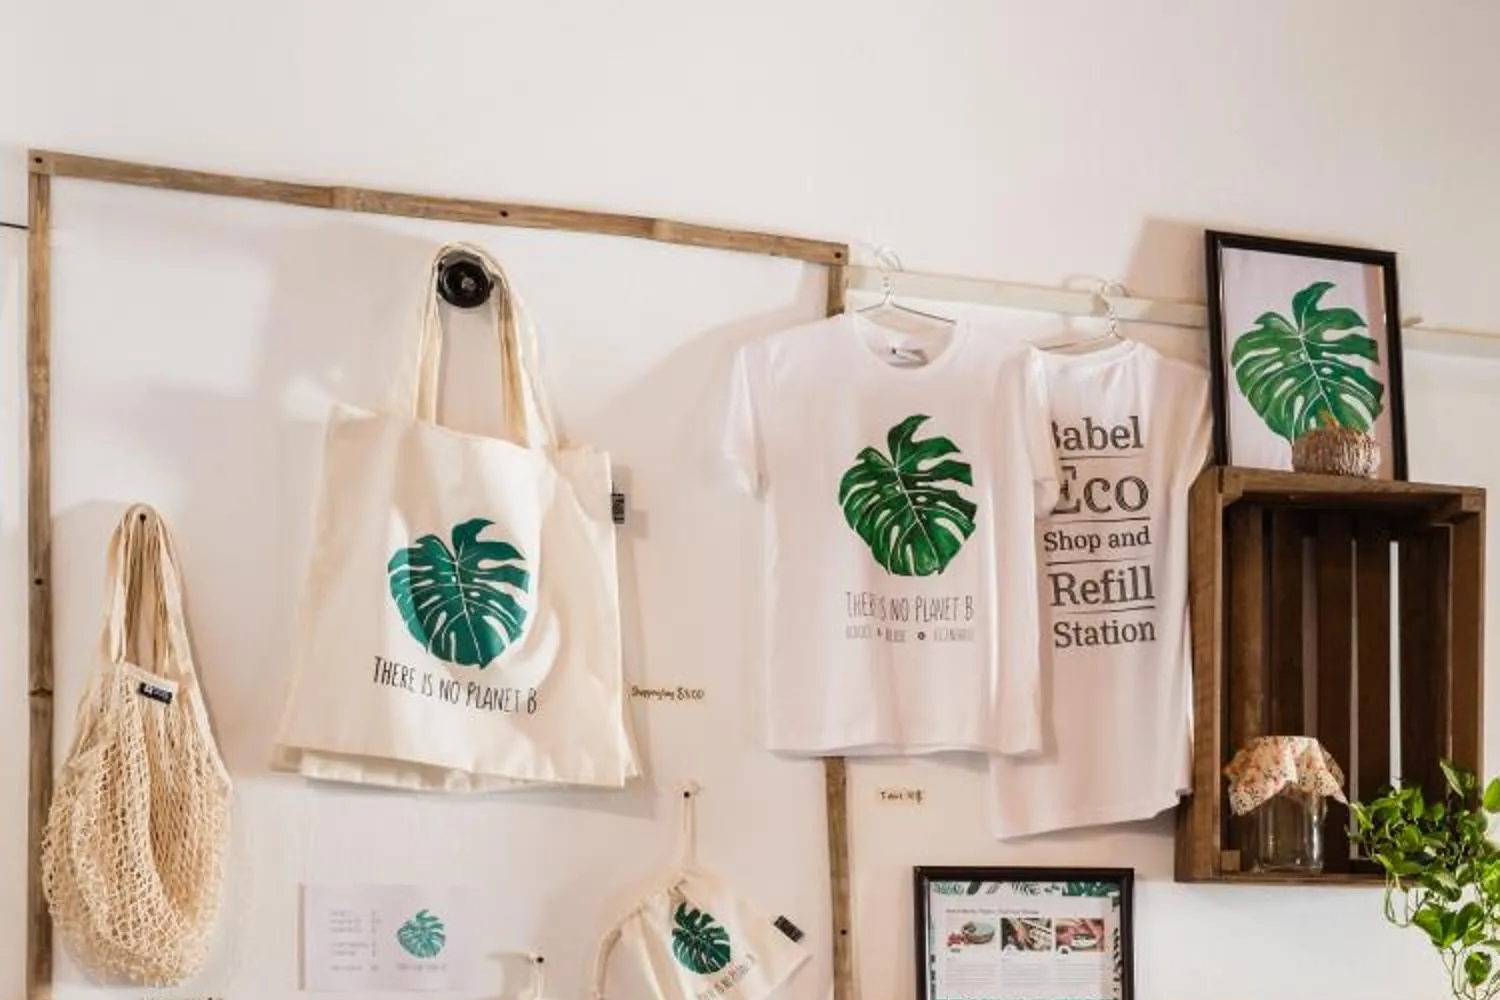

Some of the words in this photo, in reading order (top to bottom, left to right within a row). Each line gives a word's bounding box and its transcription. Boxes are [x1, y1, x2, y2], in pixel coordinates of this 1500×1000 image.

[1051, 465, 1149, 514] Eco
[1043, 531, 1101, 553] Shop
[1108, 526, 1151, 549] and
[1048, 565, 1155, 606] Refill
[890, 597, 909, 622] NO
[915, 596, 960, 622] PLANET
[964, 595, 974, 621] B
[1053, 619, 1156, 649] Station
[373, 655, 417, 693] THERE
[421, 672, 434, 697] IS
[439, 679, 461, 705] NO
[467, 681, 521, 714] PLANET
[526, 687, 538, 714] B
